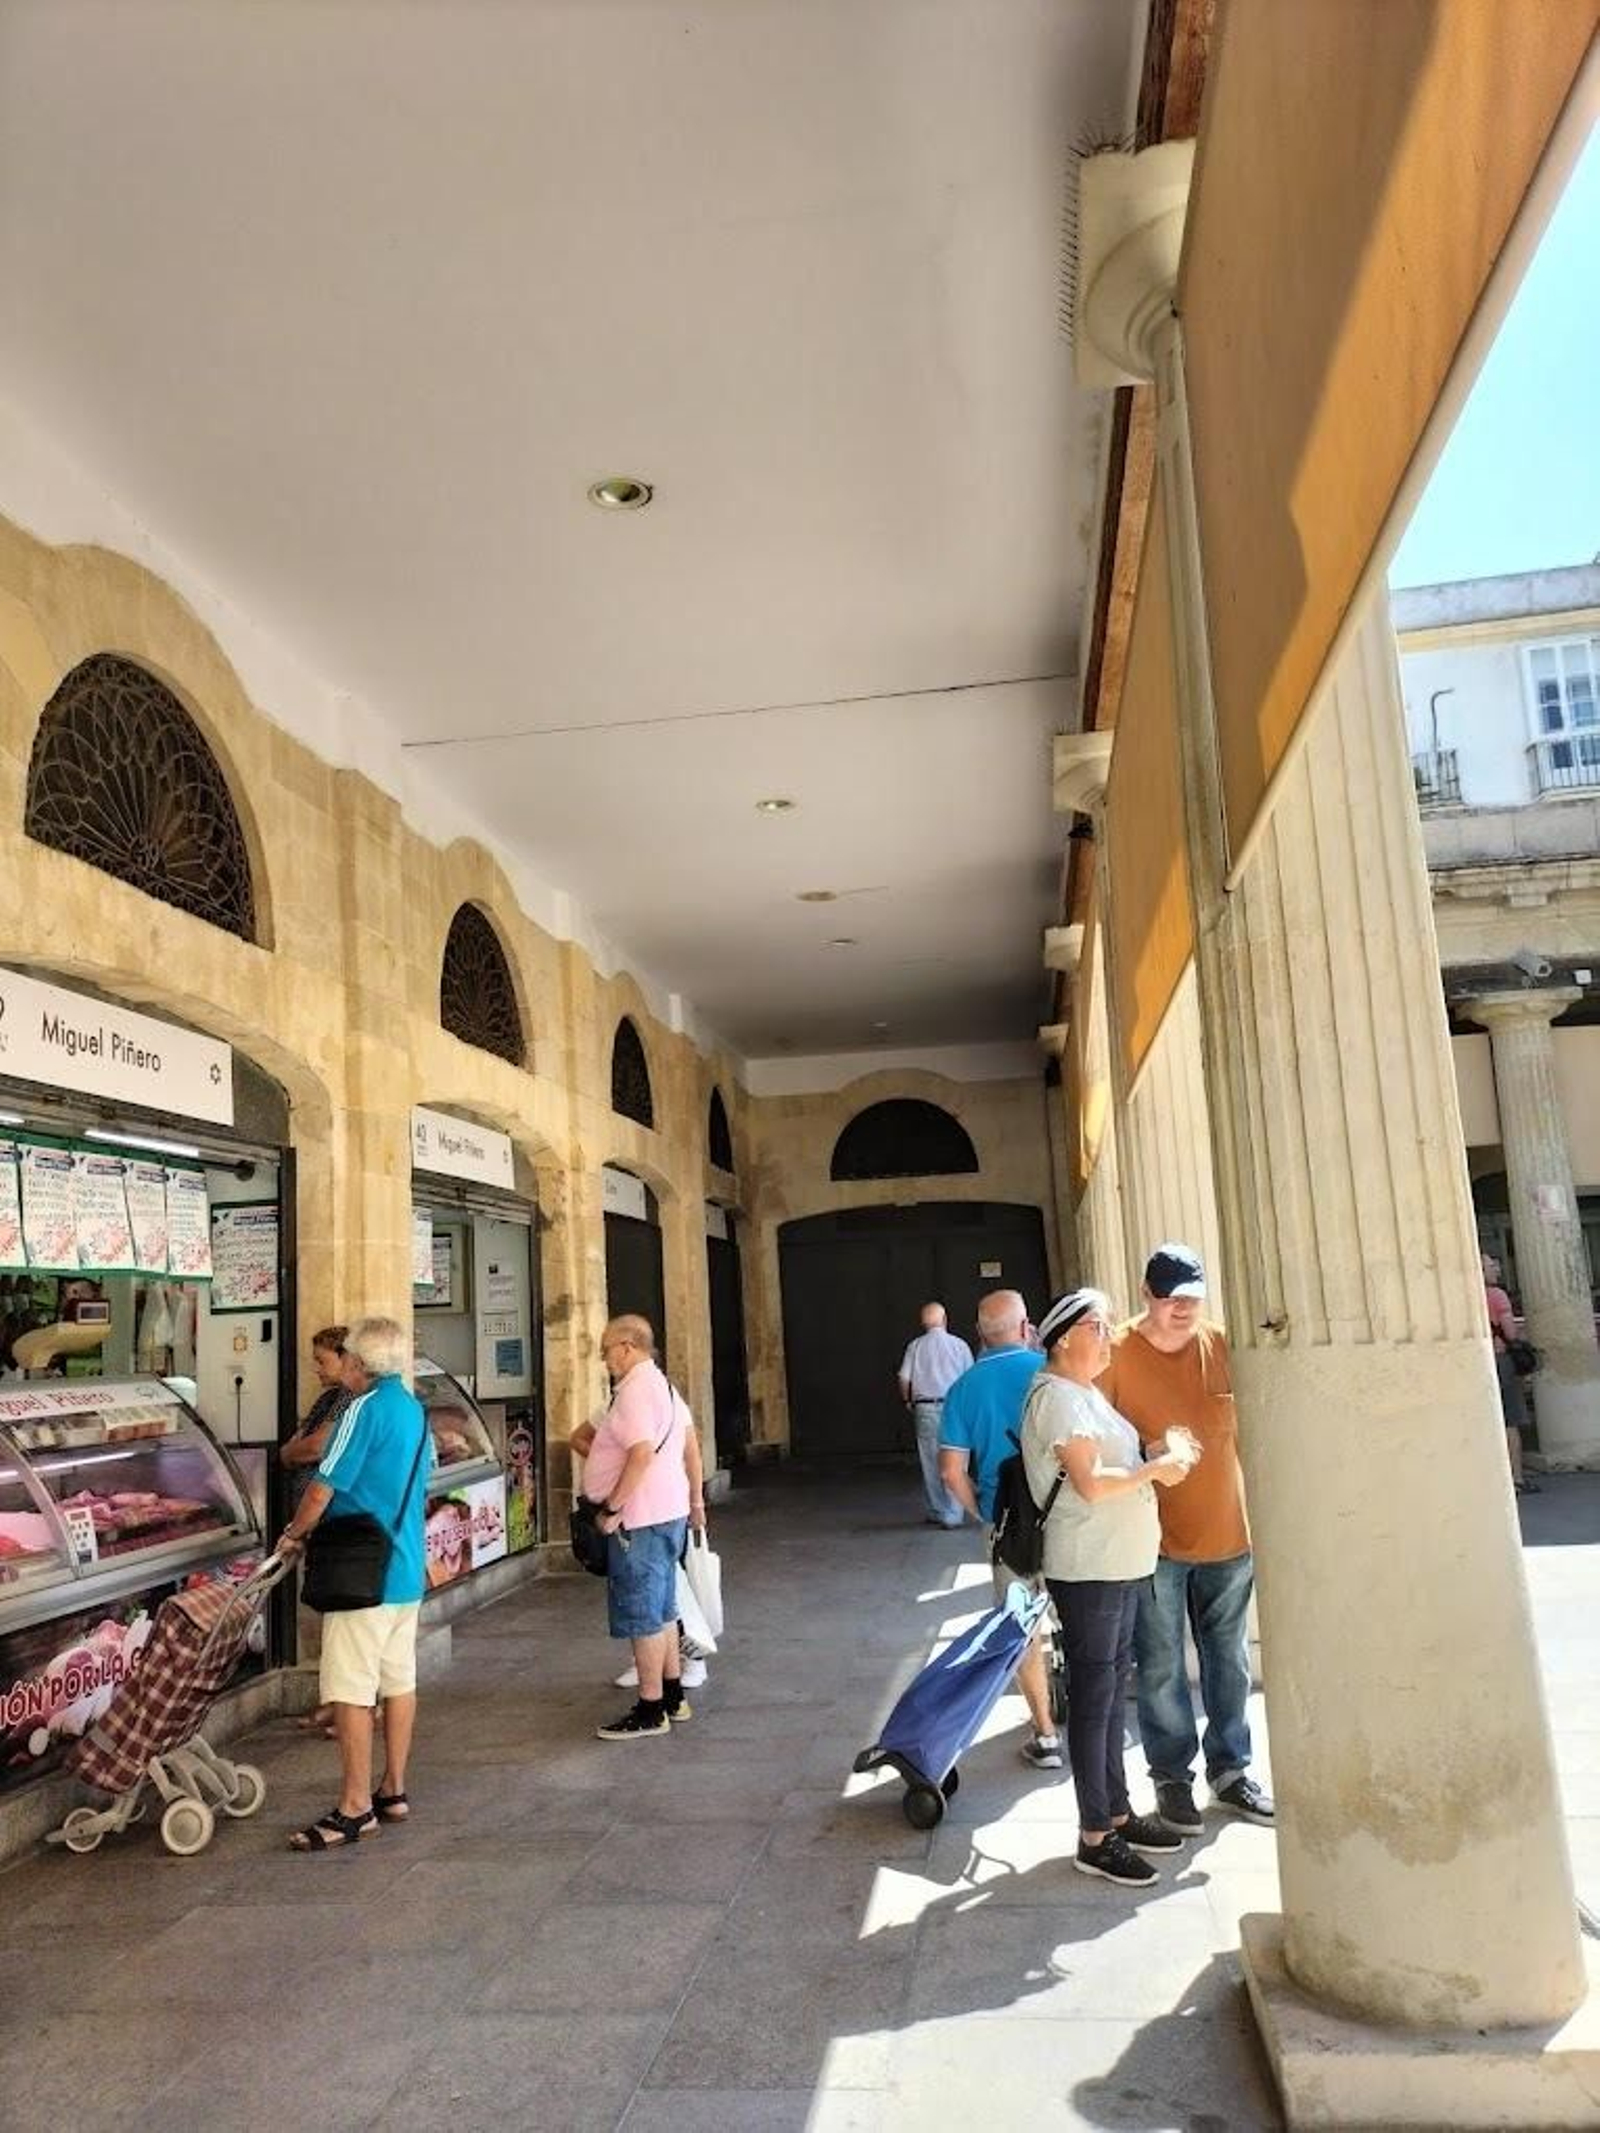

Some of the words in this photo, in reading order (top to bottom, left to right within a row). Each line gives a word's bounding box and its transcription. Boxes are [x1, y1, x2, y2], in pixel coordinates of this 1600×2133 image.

[42, 1010, 103, 1057] Miguel
[111, 1032, 162, 1072] Piñero
[50, 1664, 95, 1709] POR
[101, 1653, 125, 1685] LA
